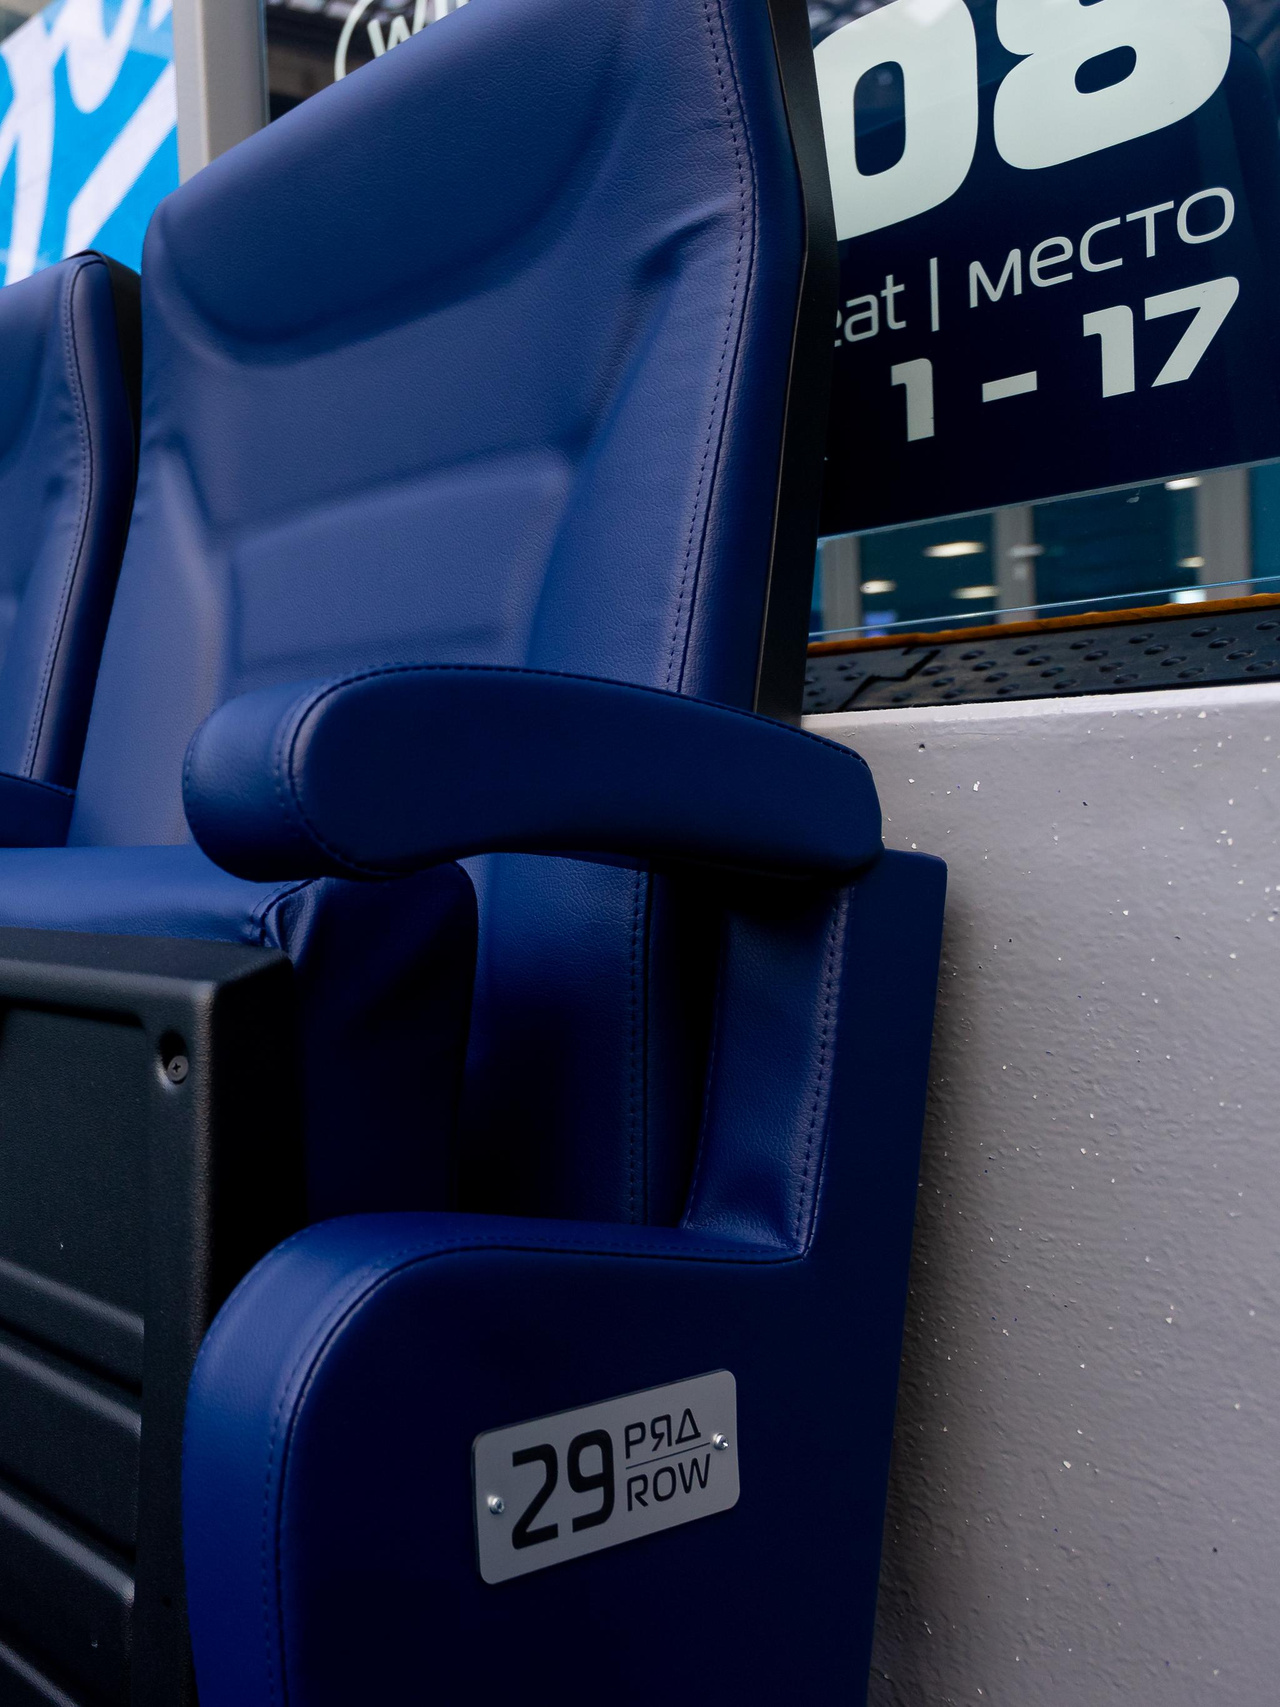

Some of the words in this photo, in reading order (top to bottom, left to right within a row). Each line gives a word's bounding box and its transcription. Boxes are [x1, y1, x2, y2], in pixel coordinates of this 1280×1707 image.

[834, 274, 907, 348] at
[891, 357, 935, 442] 1
[1083, 276, 1240, 398] 17
[512, 1429, 615, 1550] 29
[627, 1453, 711, 1512] ROW
